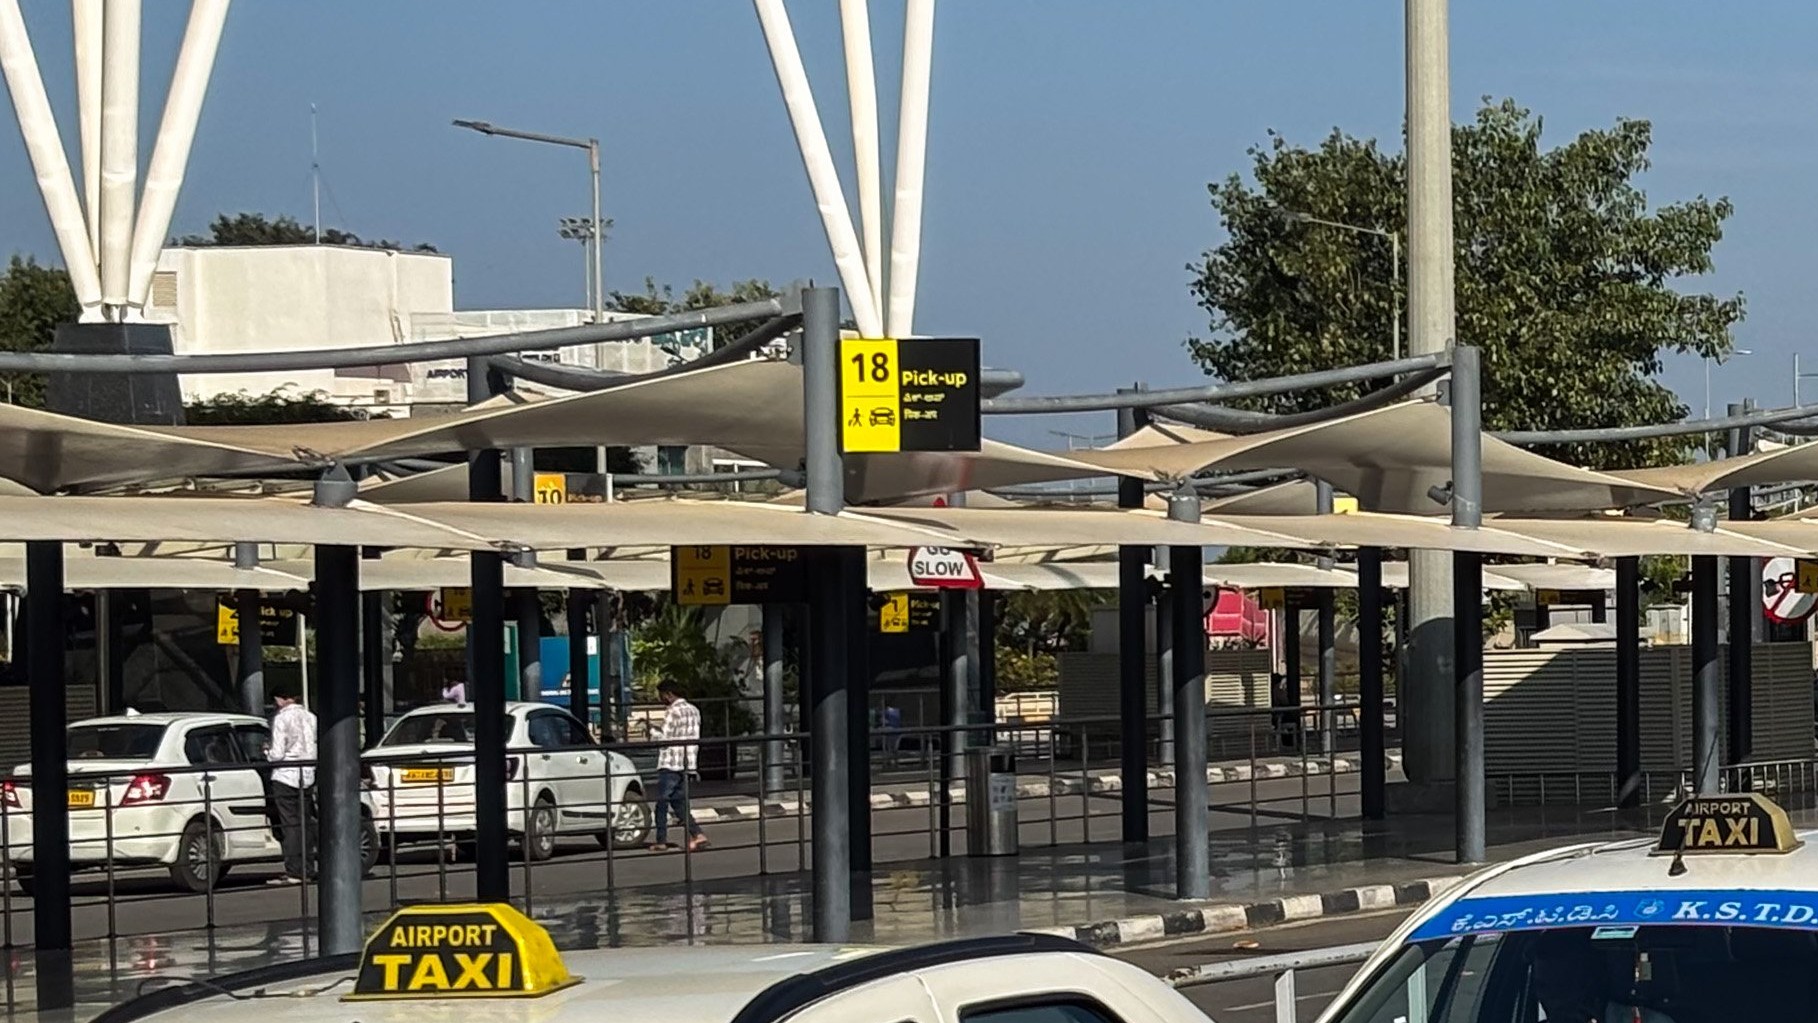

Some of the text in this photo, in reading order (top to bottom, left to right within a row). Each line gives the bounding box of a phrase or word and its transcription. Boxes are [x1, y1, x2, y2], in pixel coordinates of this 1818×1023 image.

[852, 352, 889, 382] 18
[902, 370, 967, 388] Pick-up
[915, 561, 963, 576] SLOW
[1684, 802, 1751, 816] AIRPORT
[1678, 817, 1759, 847] TAXI
[389, 924, 498, 948] AIRPORT
[372, 953, 513, 991] TAXI
